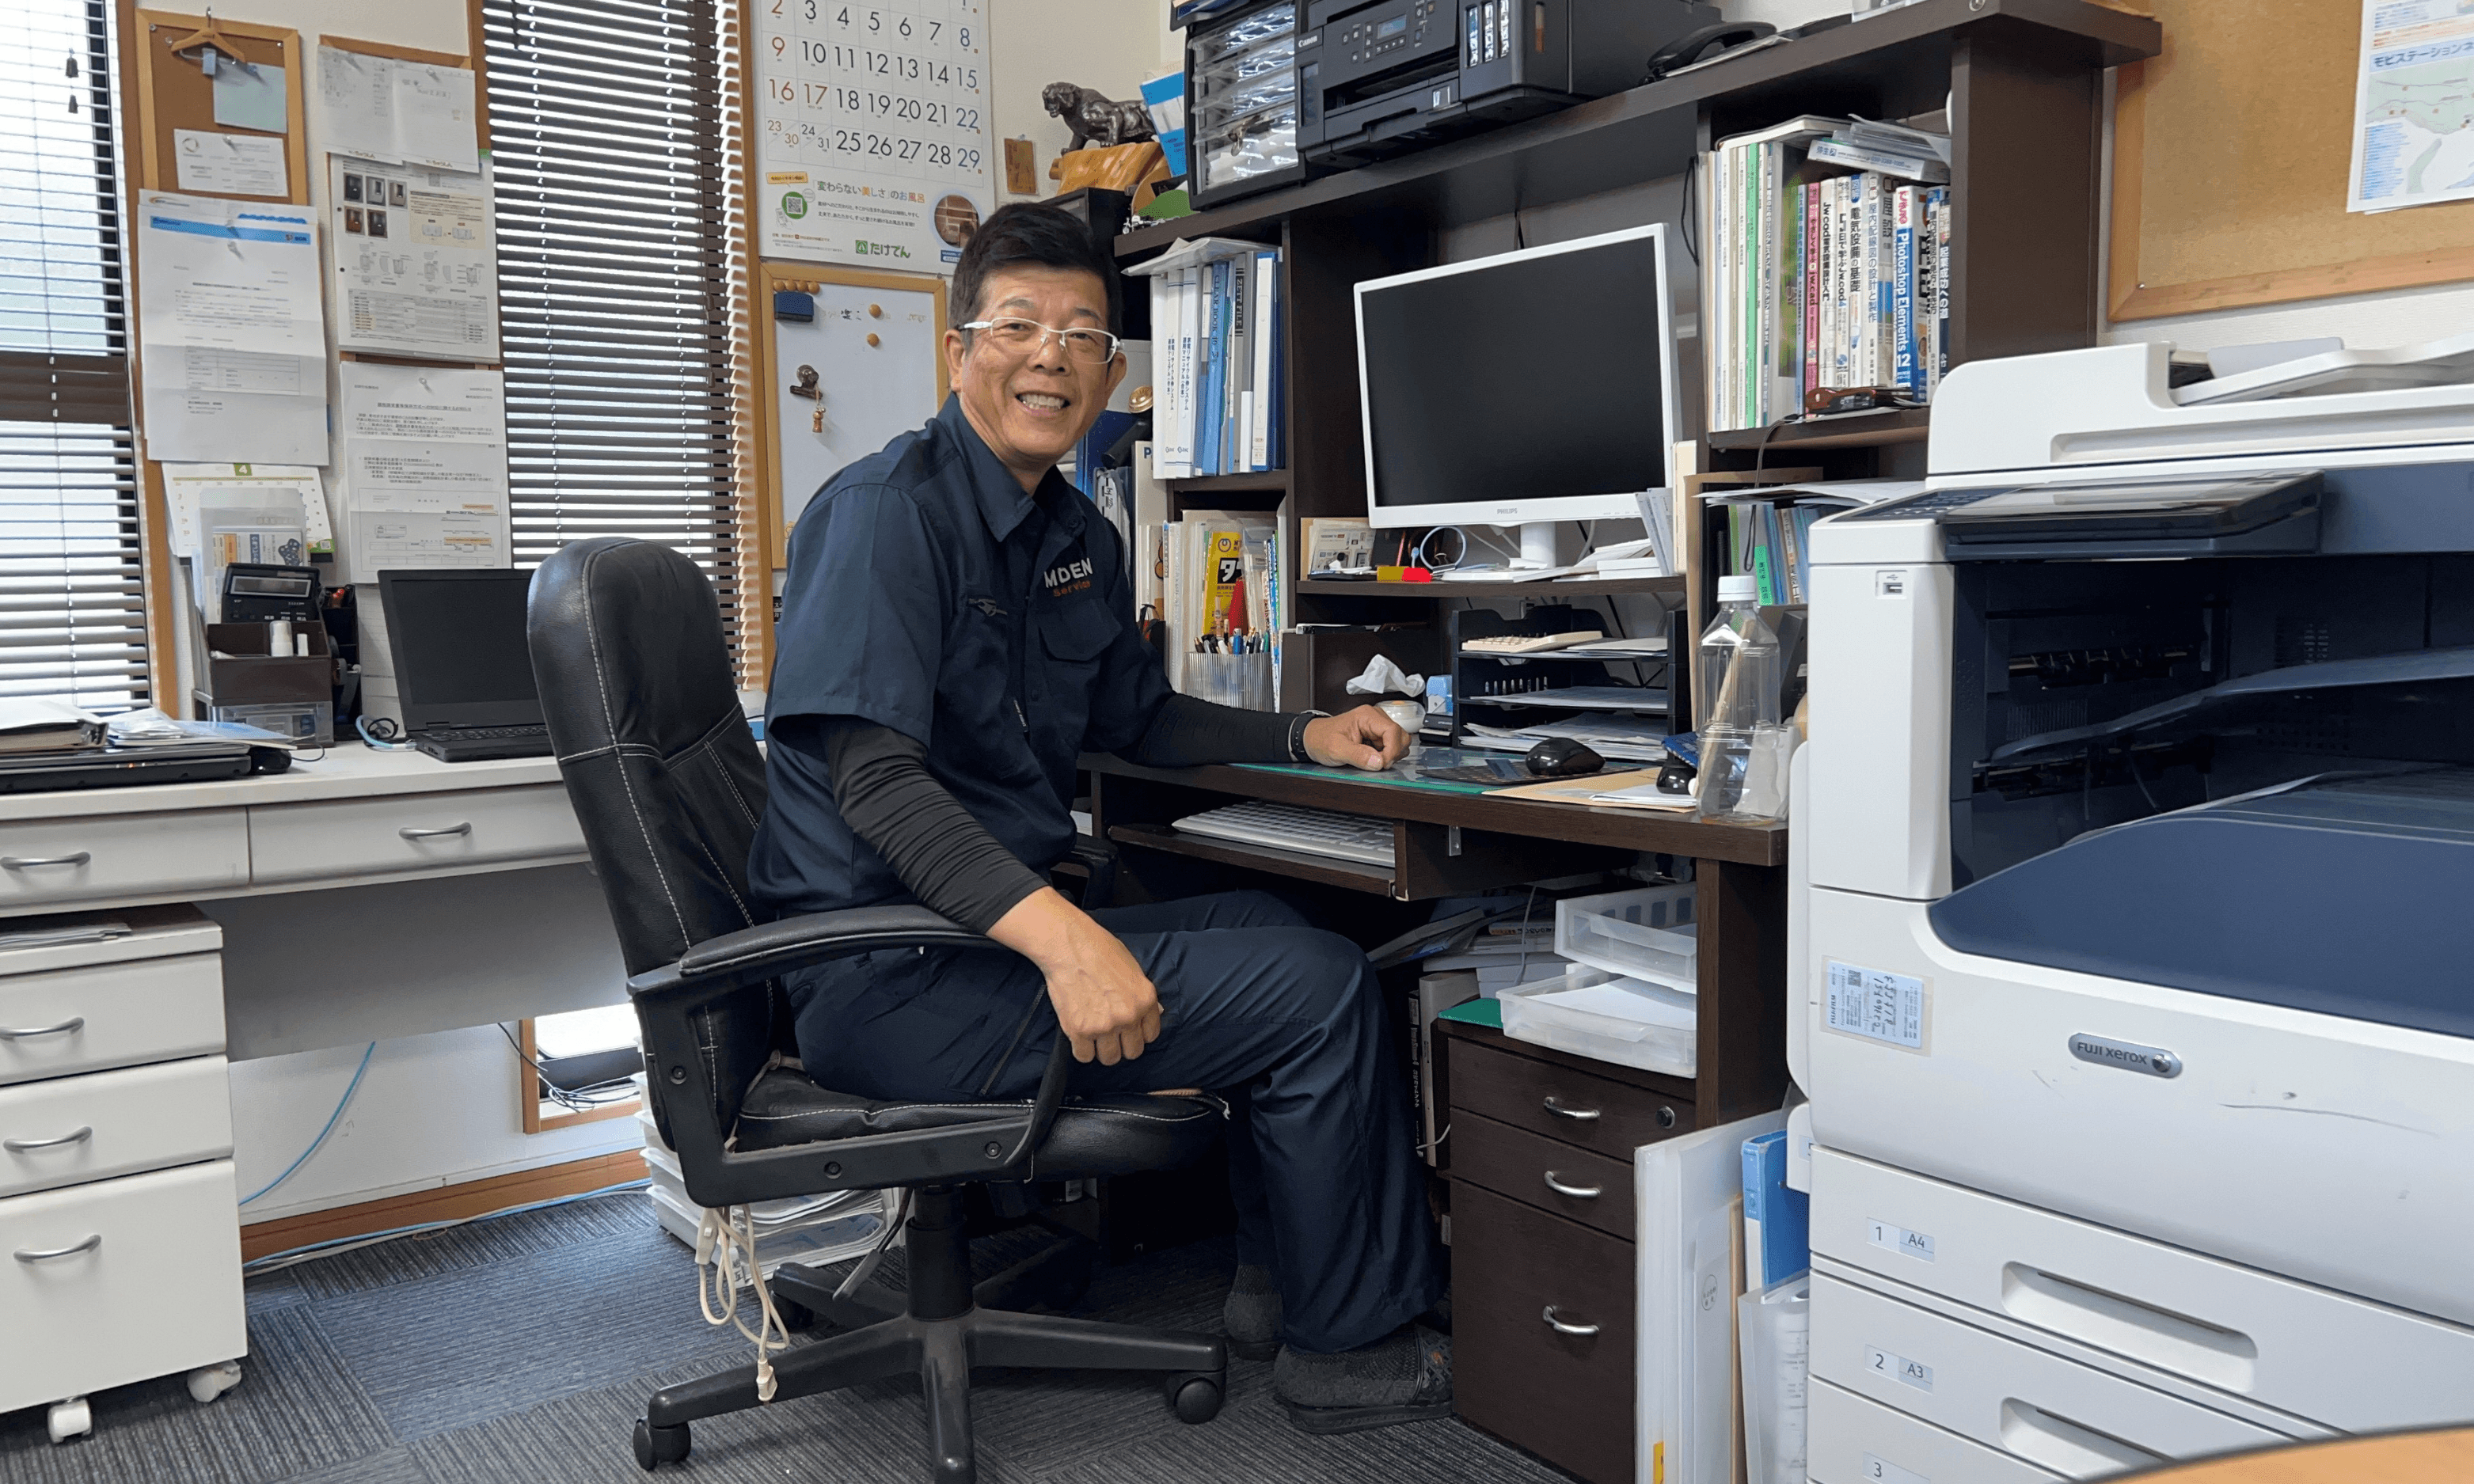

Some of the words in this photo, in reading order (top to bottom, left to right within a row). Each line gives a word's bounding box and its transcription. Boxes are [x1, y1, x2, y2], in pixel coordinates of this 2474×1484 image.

[772, 0, 783, 14] 2
[805, 0, 816, 20] 3
[837, 6, 849, 25] 4
[868, 12, 880, 31] 5
[899, 17, 911, 36] 6
[929, 21, 941, 40] 7
[960, 28, 970, 47] 8
[1298, 35, 1317, 47] Canon
[772, 37, 785, 56] 9
[802, 41, 826, 63] 10
[835, 47, 853, 68] 11
[866, 51, 888, 74] 12
[897, 57, 918, 78] 13
[928, 62, 948, 83] 14
[957, 67, 977, 88] 15
[770, 79, 794, 101] 16
[804, 84, 827, 104] 17
[837, 89, 859, 110] 18
[868, 93, 890, 114] 19
[897, 98, 921, 120] 20
[927, 103, 946, 123] 21
[956, 108, 978, 129] 22
[836, 131, 861, 152] 25
[868, 135, 891, 156] 26
[898, 139, 922, 159] 27
[928, 143, 951, 165] 28
[958, 148, 979, 168] 29
[870, 242, 911, 259] たけでん
[1898, 233, 1910, 294] Photoshop
[1898, 297, 1910, 351] Elements
[1897, 353, 1911, 366] 12
[239, 465, 248, 474] 4
[2077, 1042, 2102, 1055] FUJI
[1875, 1227, 1882, 1241] 1
[1908, 1233, 1925, 1248] A4
[1875, 1353, 1884, 1370] 2
[1907, 1363, 1924, 1379] A3
[1874, 1463, 1882, 1478] 3
